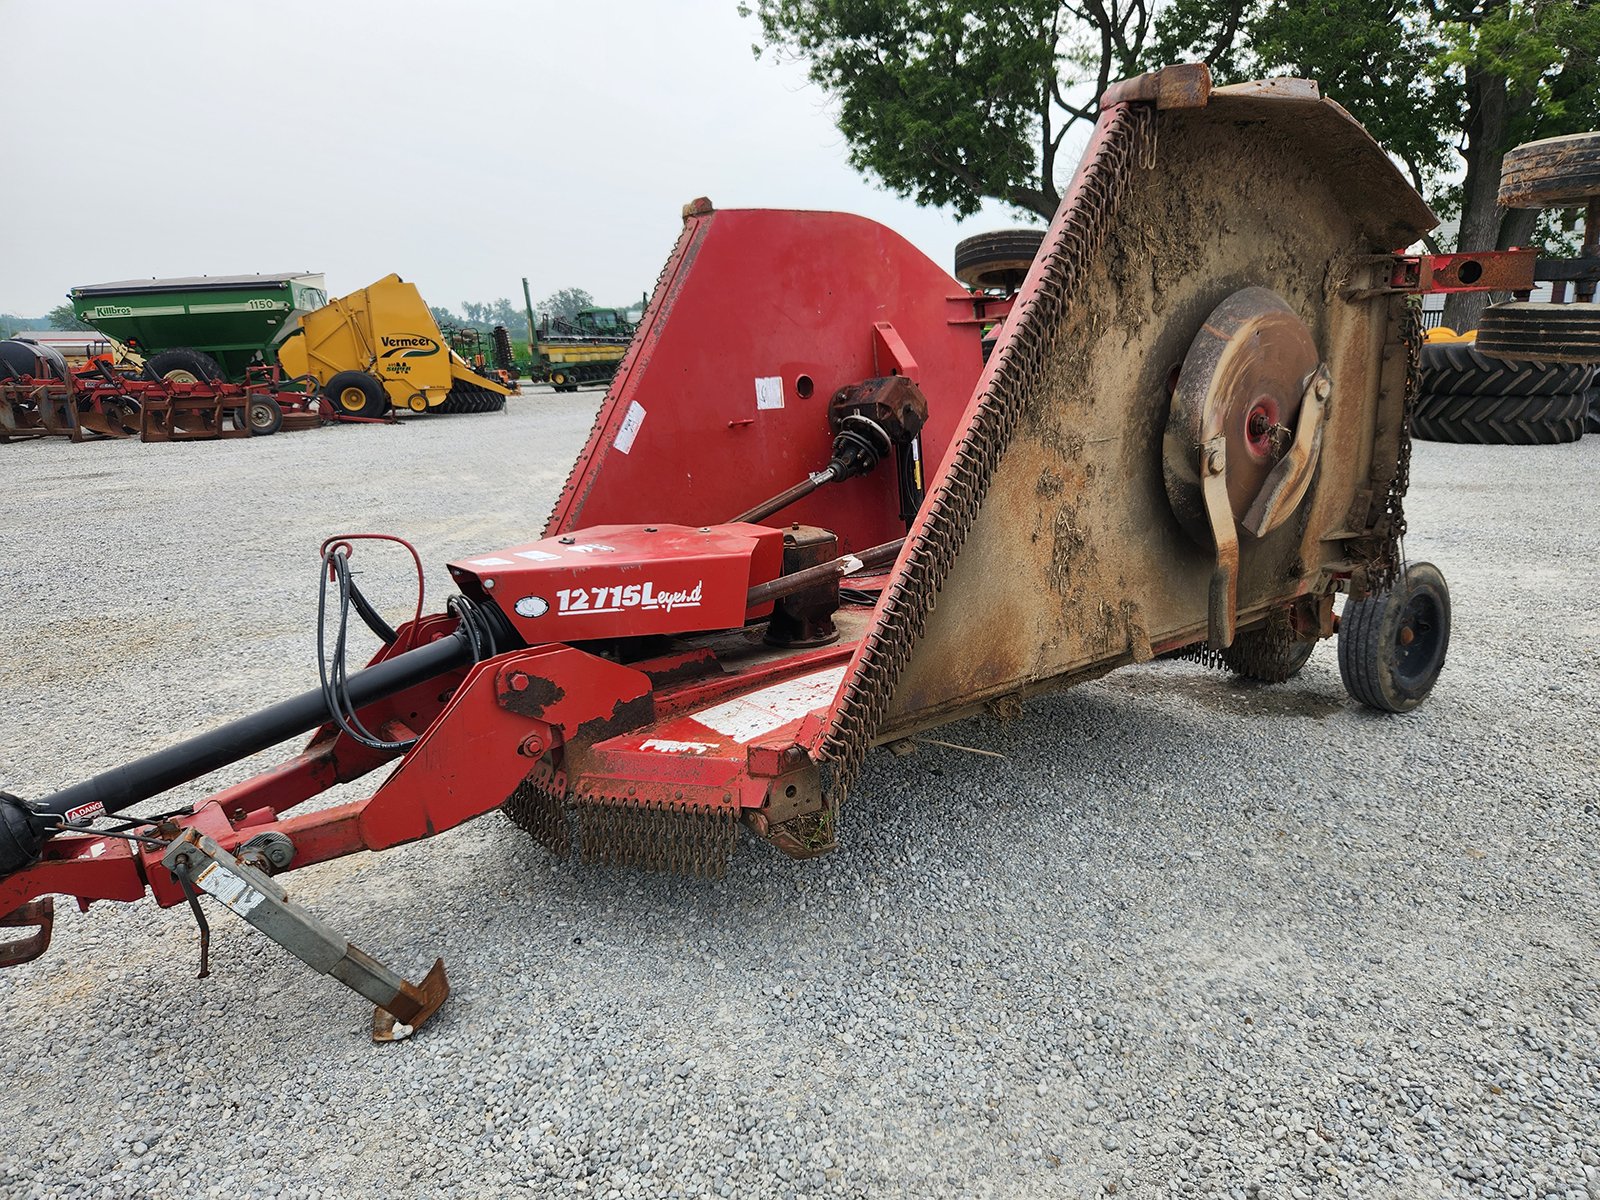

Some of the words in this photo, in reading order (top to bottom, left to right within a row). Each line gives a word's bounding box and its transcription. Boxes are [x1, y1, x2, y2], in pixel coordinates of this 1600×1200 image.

[250, 300, 273, 310] 1150
[96, 307, 131, 317] Killbros
[381, 336, 430, 347] Vermeer
